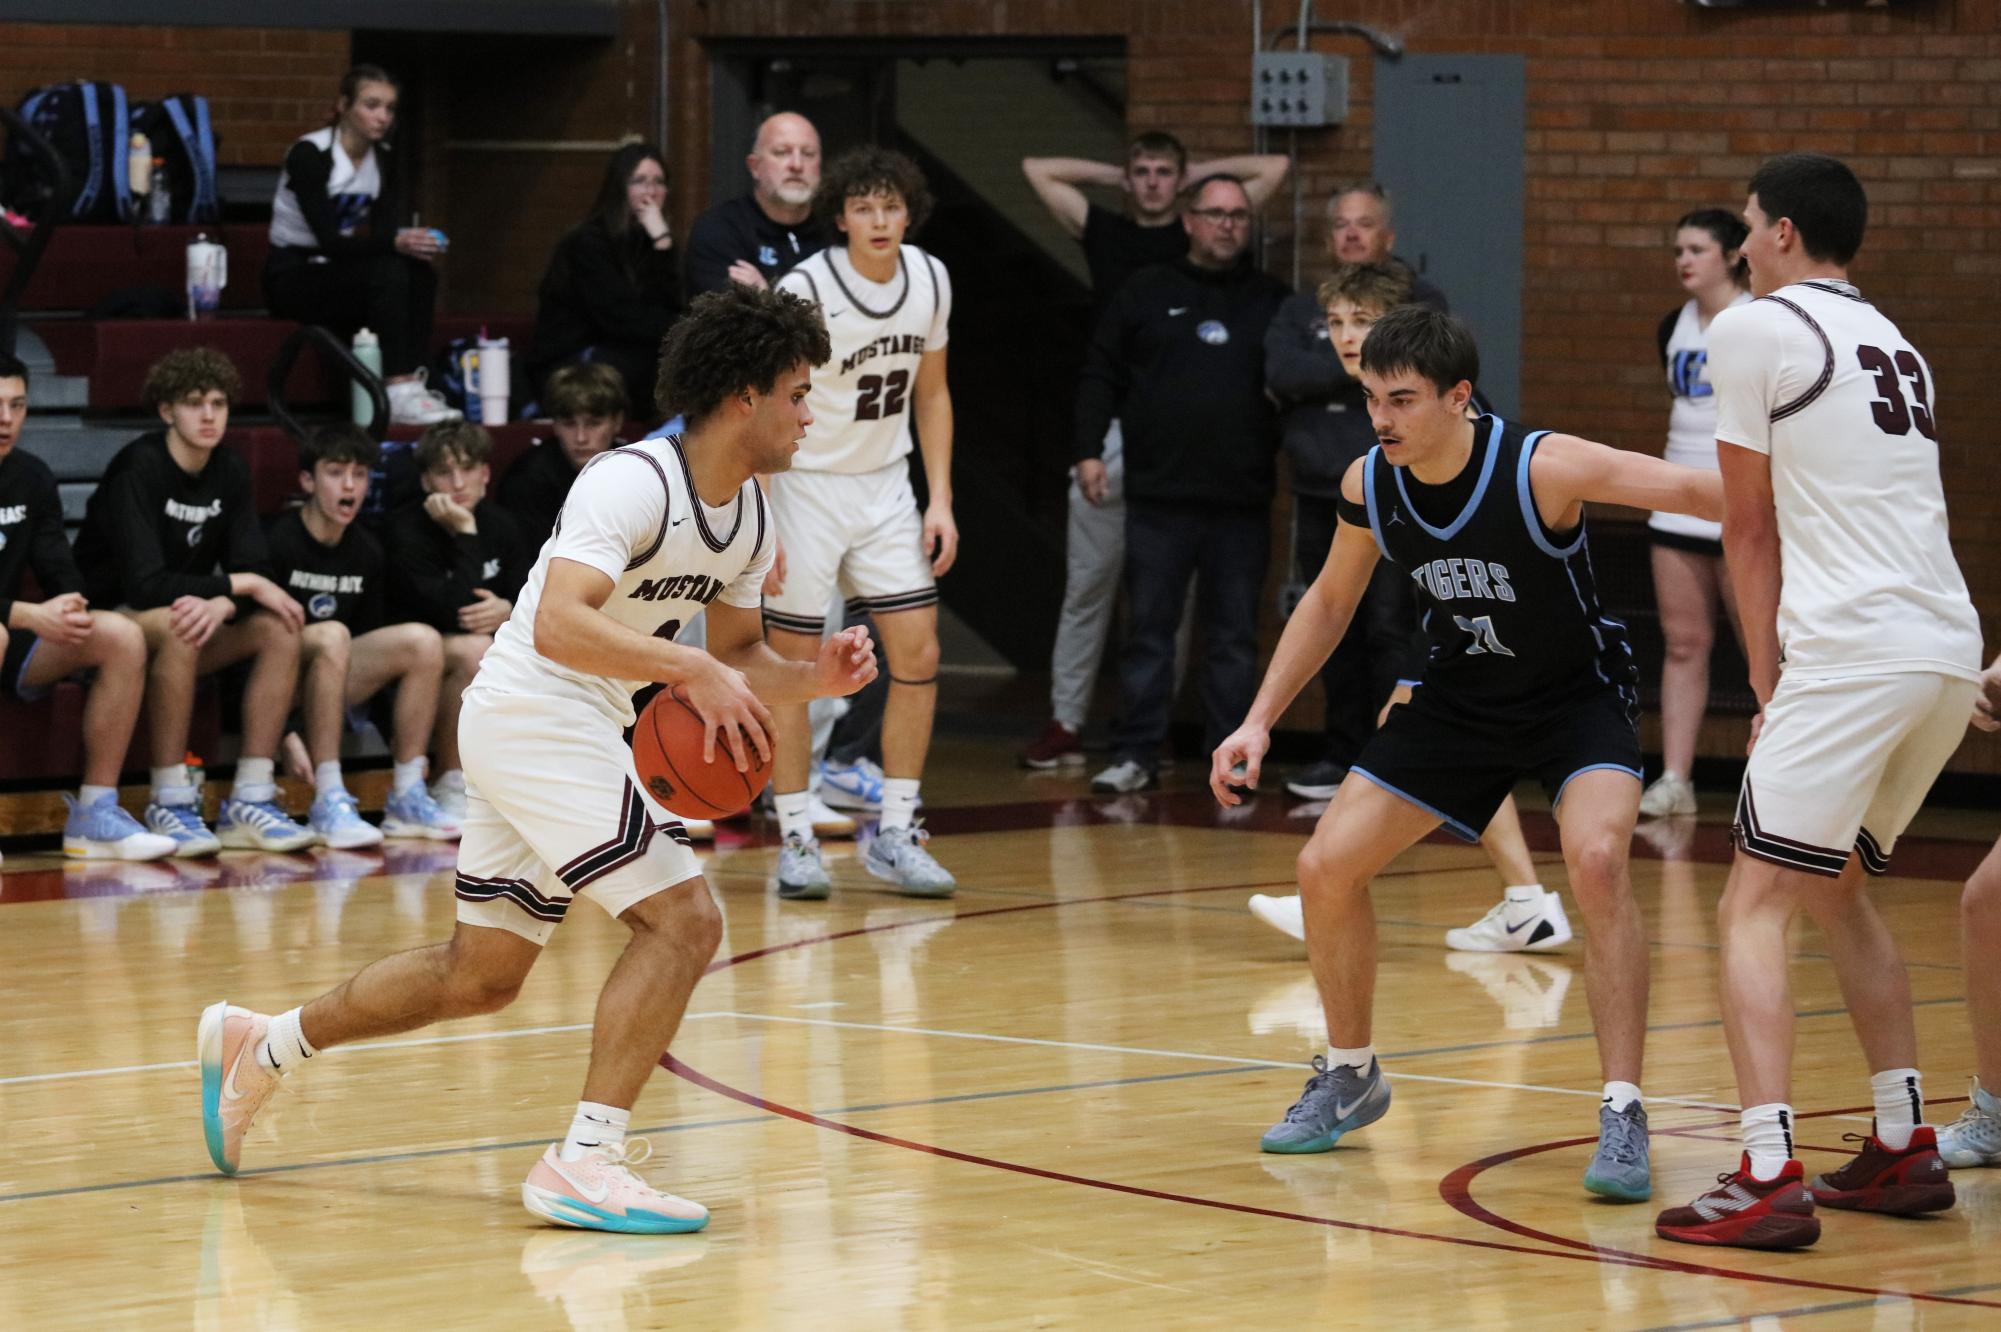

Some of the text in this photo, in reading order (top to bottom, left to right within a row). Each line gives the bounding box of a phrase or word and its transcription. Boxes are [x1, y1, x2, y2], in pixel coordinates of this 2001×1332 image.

[855, 369, 909, 421] 22
[1856, 344, 1938, 442] 33
[627, 574, 725, 606] MUSTAN
[1410, 558, 1516, 602] TIGERS
